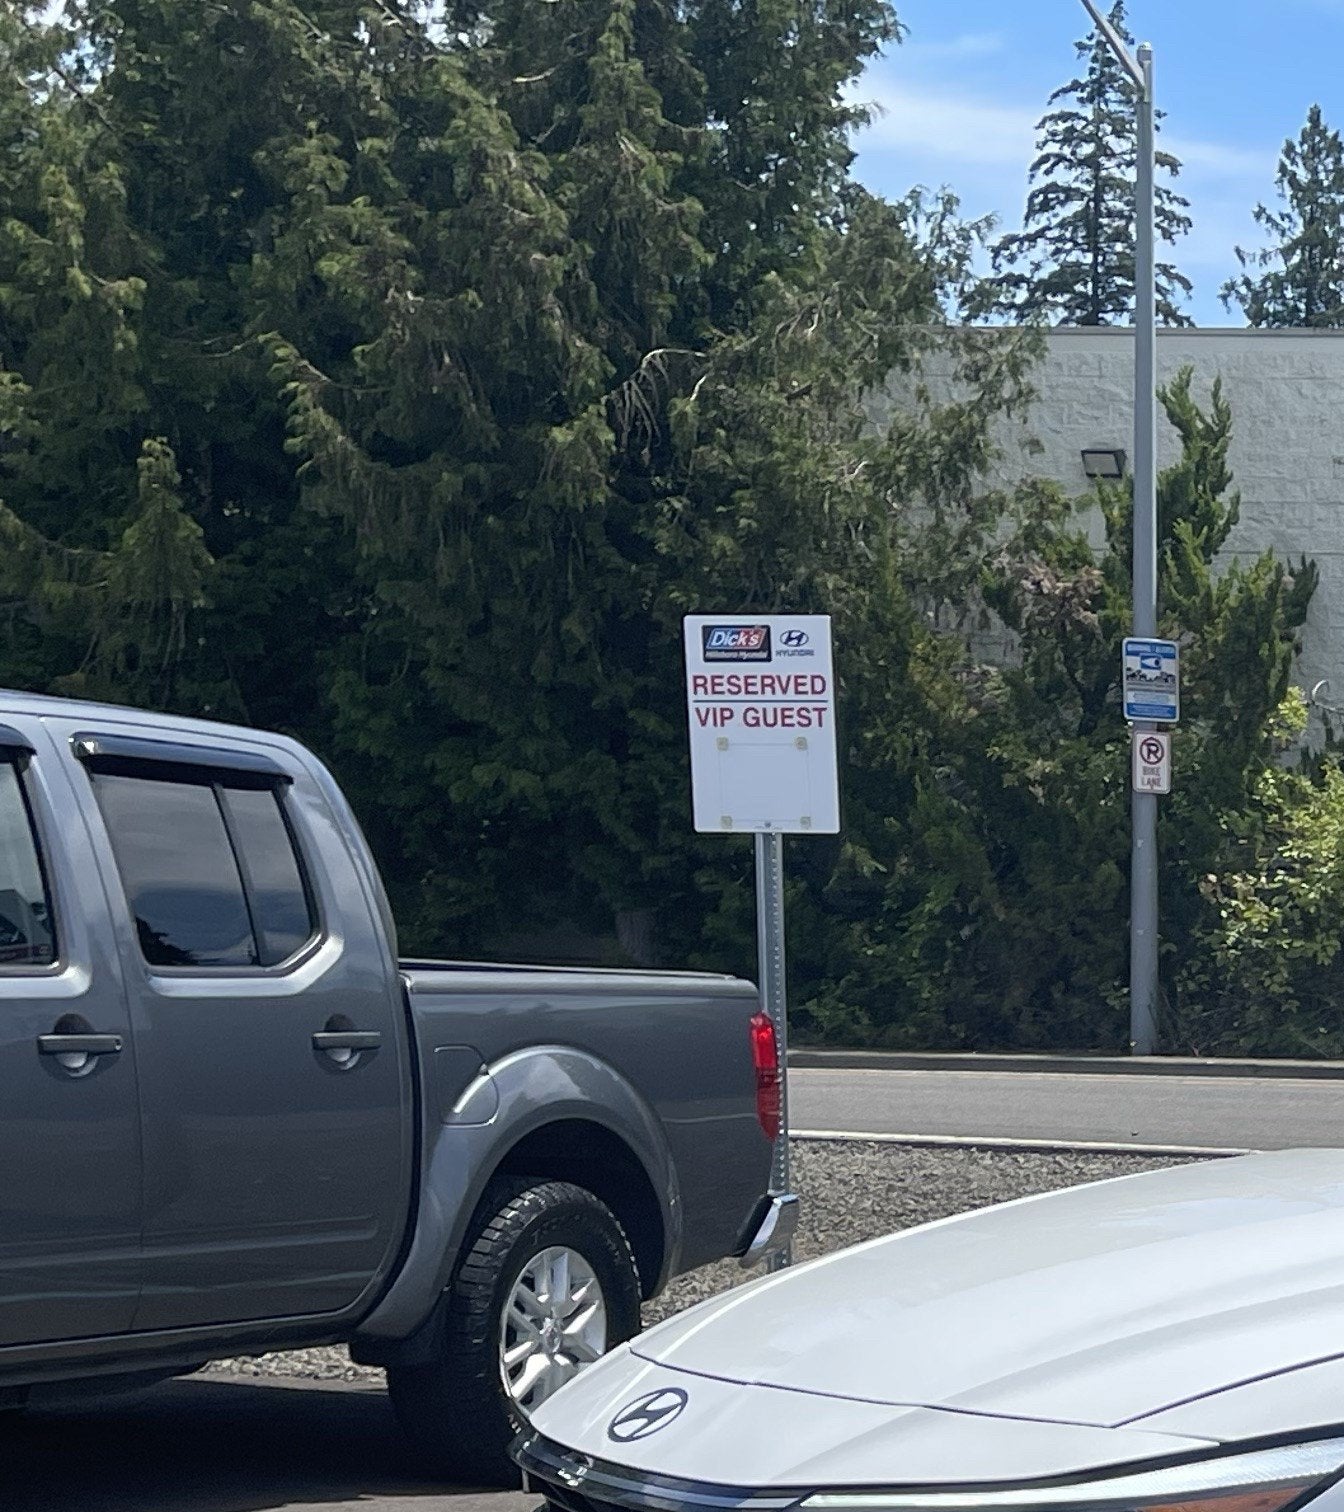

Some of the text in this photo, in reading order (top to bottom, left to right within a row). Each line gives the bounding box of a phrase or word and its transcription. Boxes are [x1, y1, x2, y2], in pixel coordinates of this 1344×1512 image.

[711, 629, 761, 647] Dick's
[692, 674, 827, 695] RESERVED
[695, 707, 828, 728] VIP GUEST
